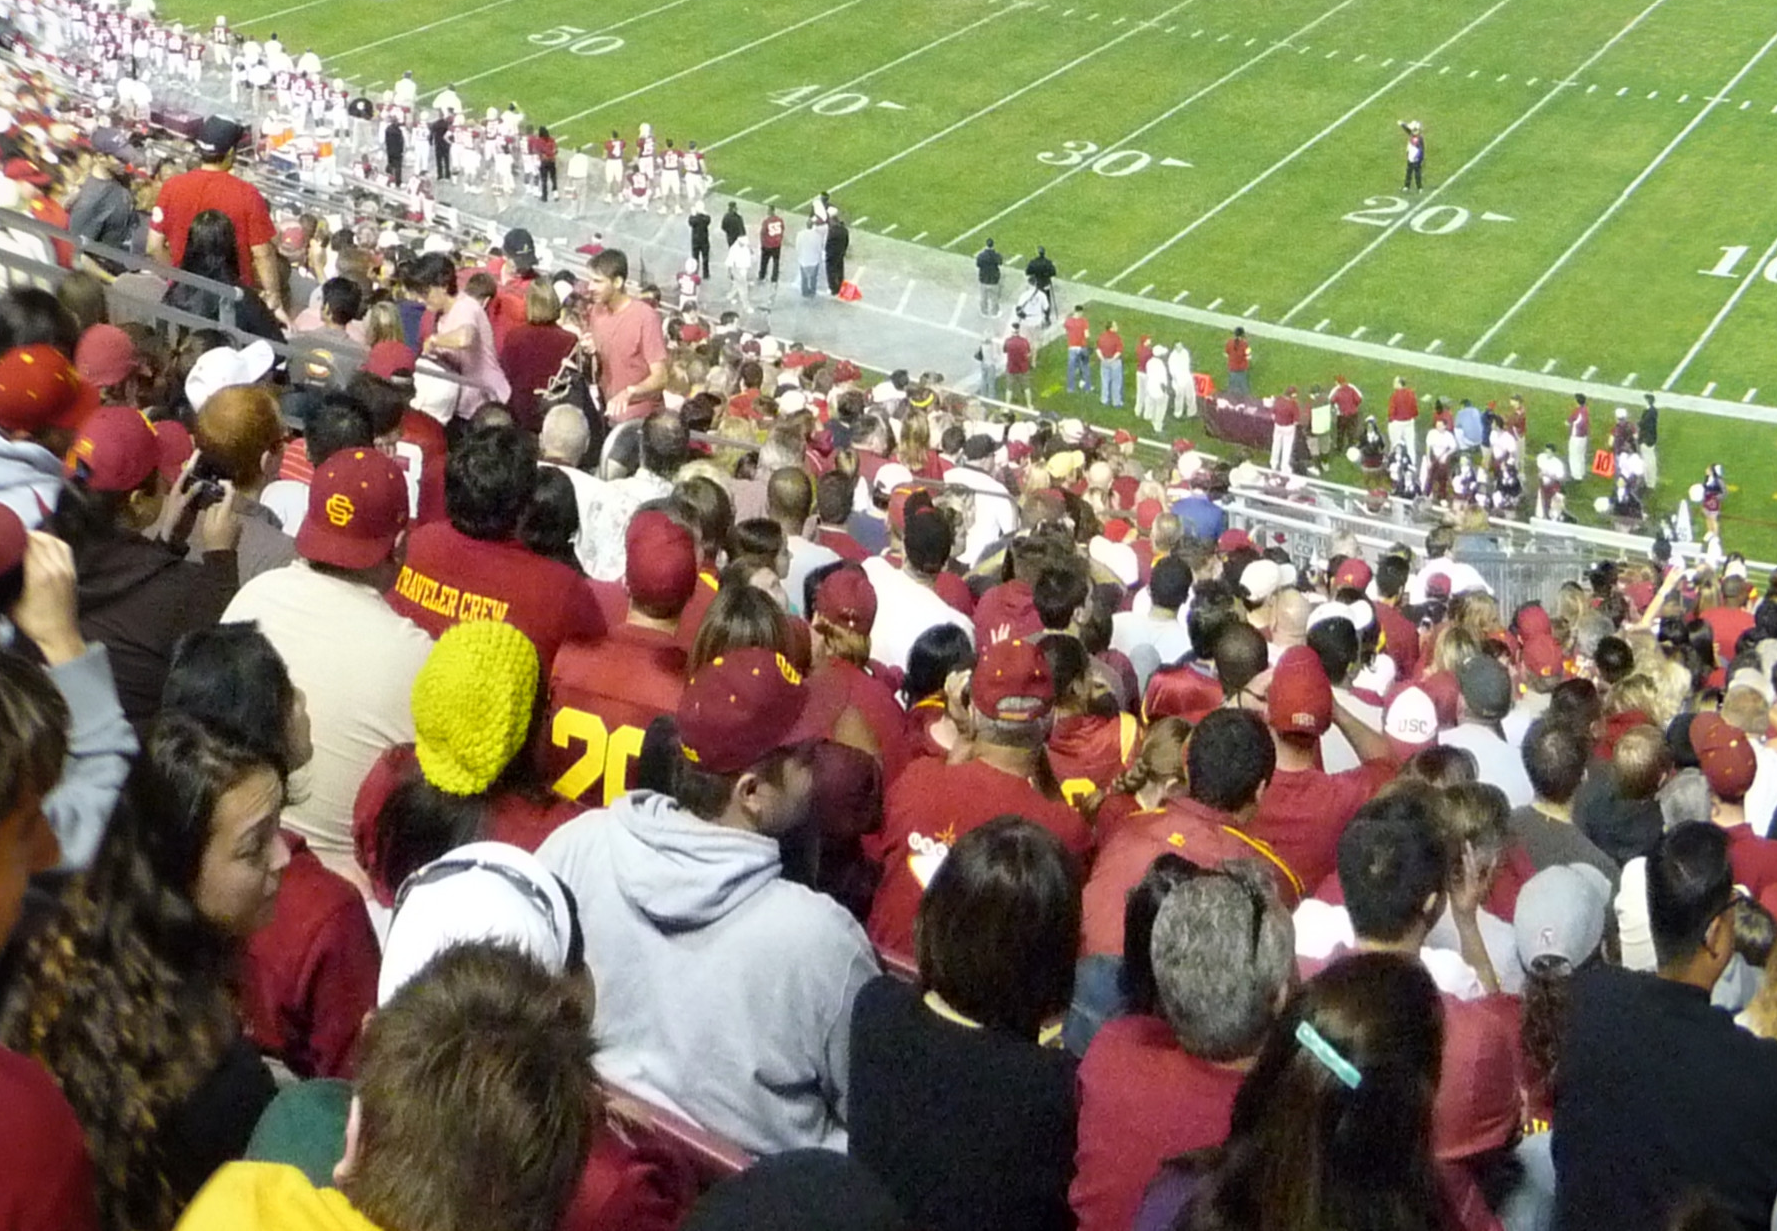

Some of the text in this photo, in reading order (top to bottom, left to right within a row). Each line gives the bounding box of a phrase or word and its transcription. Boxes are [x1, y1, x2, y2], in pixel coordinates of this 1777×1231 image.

[527, 25, 625, 55] 50
[769, 85, 870, 116] 40
[1036, 140, 1151, 177] 30
[768, 221, 782, 236] 55
[1340, 195, 1470, 234] 20
[1595, 451, 1611, 473] 10
[394, 564, 509, 624] TRAVELER CREW
[1397, 718, 1428, 734] USC
